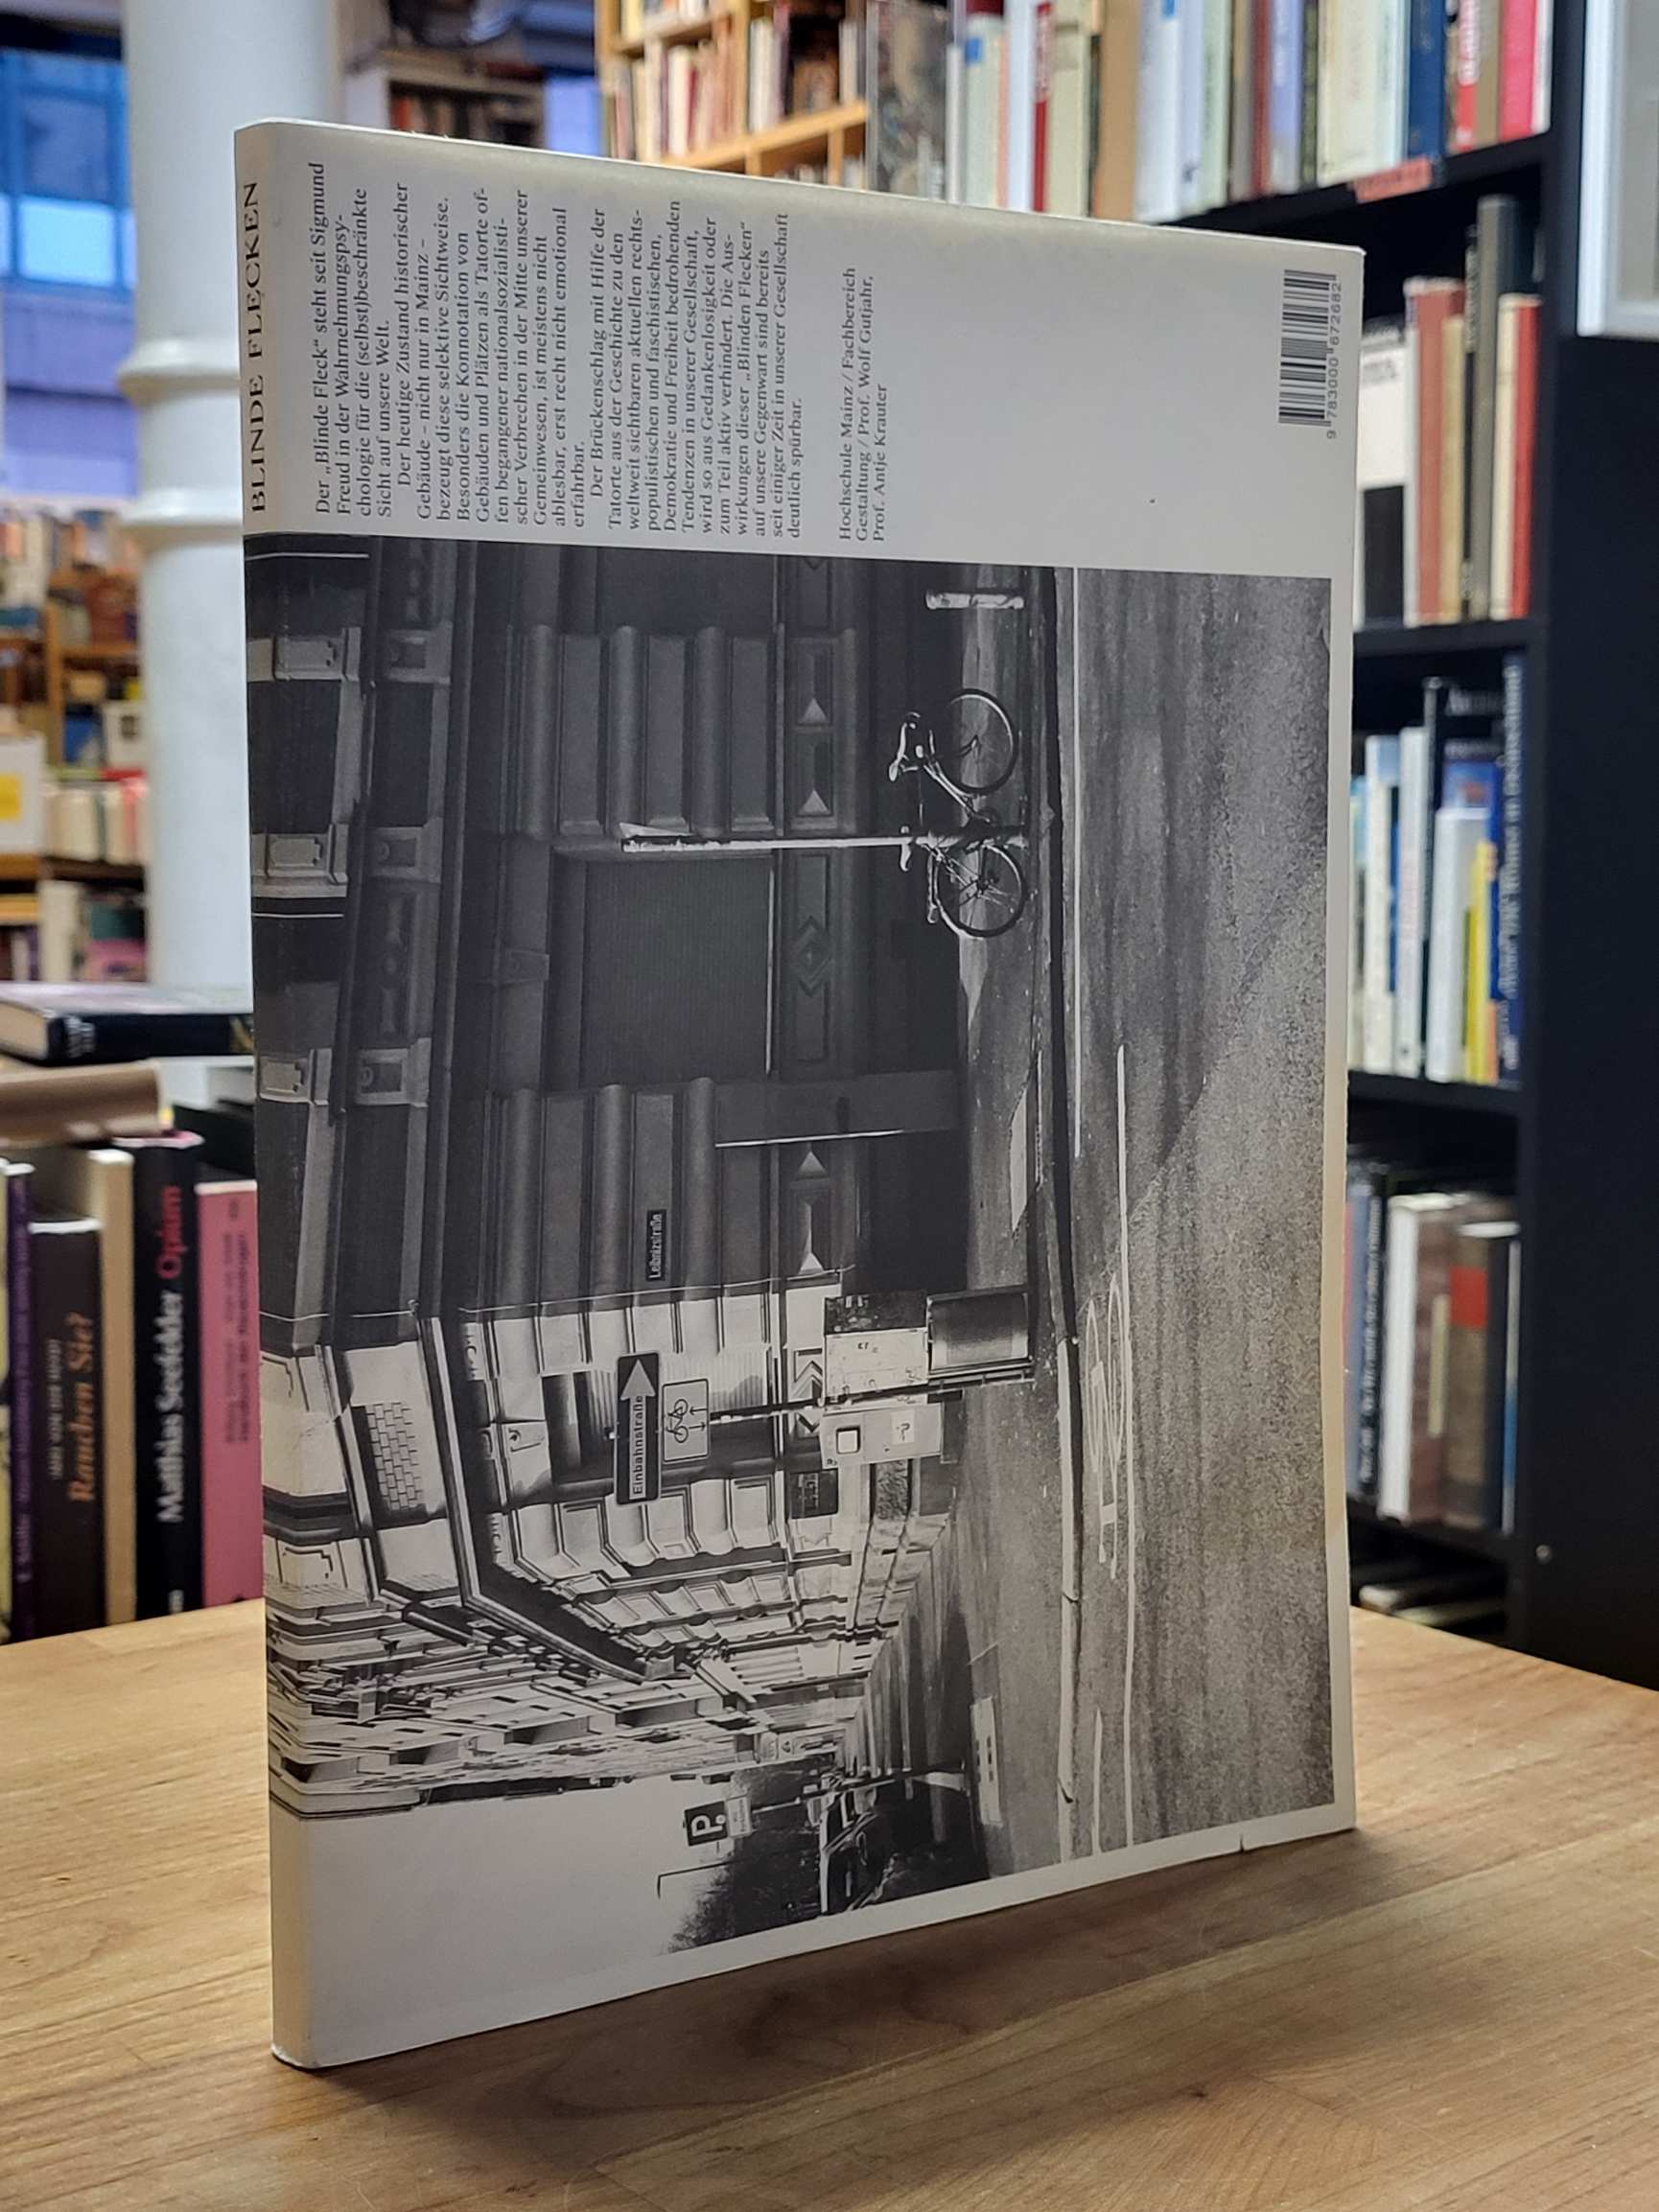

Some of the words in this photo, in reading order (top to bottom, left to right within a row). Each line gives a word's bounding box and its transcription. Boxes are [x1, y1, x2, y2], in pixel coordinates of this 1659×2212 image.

[311, 163, 329, 245] Sigmund
[475, 188, 488, 214] of-
[518, 190, 528, 257] unserer
[592, 209, 605, 239] der
[394, 182, 409, 294] historischer
[434, 198, 449, 302] Sichtweise.
[459, 233, 469, 266] von
[475, 219, 488, 285] Tatorte
[533, 237, 548, 280] nicht
[552, 208, 567, 300] emotional
[591, 244, 605, 288] Hilfe
[610, 233, 623, 265] den
[628, 210, 643, 269] rechts-
[666, 201, 681, 314] bedrohenden
[702, 218, 716, 259] oder
[719, 235, 734, 274] Aus-
[773, 214, 788, 317] Gesellschaft
[243, 181, 263, 359] FLECKEN
[313, 251, 327, 283] seit
[353, 189, 372, 366] (selbst)beschränkte
[415, 254, 430, 310] Mainz
[514, 263, 528, 309] Mitte
[614, 270, 623, 291] zu
[683, 230, 700, 343] Gesellschaft,
[719, 279, 734, 308] Die
[755, 250, 769, 308] bereits
[313, 290, 328, 333] steht
[334, 215, 353, 397] Wahrnehmungspsy-
[415, 316, 430, 334] in
[475, 291, 489, 316] als
[495, 219, 508, 382] nationalsozialisti-
[533, 286, 548, 364] meistens
[591, 295, 605, 324] mit
[627, 276, 643, 357] aktuellen
[646, 235, 664, 362] faschistischen,
[840, 268, 855, 369] Fachbereich
[858, 276, 876, 343] Gutjahr,
[1329, 282, 1342, 346] 672682
[376, 321, 390, 365] Welt.
[395, 300, 409, 374] Zustand
[419, 338, 430, 369] nur
[435, 307, 450, 389] selektive
[456, 272, 470, 386] Konnotation
[475, 322, 489, 387] Plätzen
[514, 314, 528, 344] der
[552, 307, 567, 351] nicht
[609, 296, 623, 393] Geschichte
[665, 321, 679, 387] Freiheit
[700, 265, 718, 431] Gedankenlosigkeit
[754, 313, 768, 348] sind
[775, 322, 786, 384] unserer
[356, 372, 369, 400] die
[514, 350, 528, 366] in
[533, 370, 547, 389] ist
[552, 357, 567, 401] recht
[646, 368, 661, 400] und
[686, 347, 697, 412] unserer
[718, 315, 733, 407] verhindert.
[857, 347, 872, 388] Wolf
[380, 373, 390, 431] unsere
[396, 381, 413, 447] heutige
[416, 376, 431, 420] nicht
[456, 393, 470, 421] die
[475, 394, 489, 427] und
[590, 330, 608, 459] Brückenschlag
[609, 398, 622, 427] der
[627, 362, 642, 453] sichtbaren
[665, 393, 679, 425] und
[736, 386, 750, 439] dieser
[753, 354, 771, 444] Gegenwart
[771, 389, 785, 405] in
[839, 386, 853, 437] Mainz
[856, 395, 871, 435] Prof.
[873, 384, 887, 446] Krauter
[1327, 357, 1340, 419] 783000
[247, 375, 267, 513] BLINDE
[336, 404, 350, 434] der
[356, 404, 370, 431] für
[435, 395, 450, 443] diese
[495, 386, 512, 490] begangener
[514, 372, 528, 472] Verbrechen
[553, 408, 567, 440] erst
[613, 431, 622, 460] aus
[682, 418, 696, 433] in
[717, 412, 732, 454] aktiv
[770, 410, 784, 441] Zeit
[787, 399, 806, 466] spürbar.
[1326, 430, 1337, 439] 9
[337, 440, 350, 456] in
[356, 437, 374, 516] chologie
[377, 436, 391, 467] auf
[397, 453, 410, 485] Der
[456, 427, 470, 521] Besonders
[533, 397, 549, 524] Gemeinwesen,
[645, 406, 663, 531] populistischen
[704, 436, 713, 465] aus
[717, 460, 732, 493] Teil
[769, 446, 787, 504] einiger
[872, 453, 890, 496] Antje
[316, 480, 331, 513] Der
[337, 463, 351, 514] Freud
[377, 473, 391, 517] Sicht
[416, 440, 431, 519] Gebäude
[436, 449, 454, 520] bezeugt
[476, 433, 489, 523] Gebäuden
[514, 477, 528, 524] scher
[552, 447, 568, 526] ablesbar,
[571, 442, 585, 527] erfahrbar.
[589, 465, 603, 497] Der
[608, 466, 622, 529] Tatorte
[626, 458, 641, 529] weltweit
[664, 431, 678, 531] Demokratie
[681, 440, 696, 533] Tendenzen
[703, 470, 713, 489] so
[735, 445, 753, 535] wirkungen
[756, 450, 766, 504] unsere
[786, 472, 802, 538] deutlich
[838, 444, 853, 540] Hochschule
[855, 453, 874, 542] Gestaltung
[495, 496, 508, 523] fen
[699, 495, 713, 533] wird
[720, 499, 731, 534] zum
[752, 508, 766, 536] auf
[769, 509, 783, 537] seit
[872, 502, 886, 542] Prof.
[157, 1185, 187, 1279] Opium
[65, 1311, 94, 1372] Sie?
[155, 1291, 184, 1410] Seefelder
[67, 1382, 95, 1502] Rauchen
[156, 1414, 184, 1523] Matthias
[632, 1395, 644, 1495] Einbahnstraße
[690, 1814, 724, 1837] P
